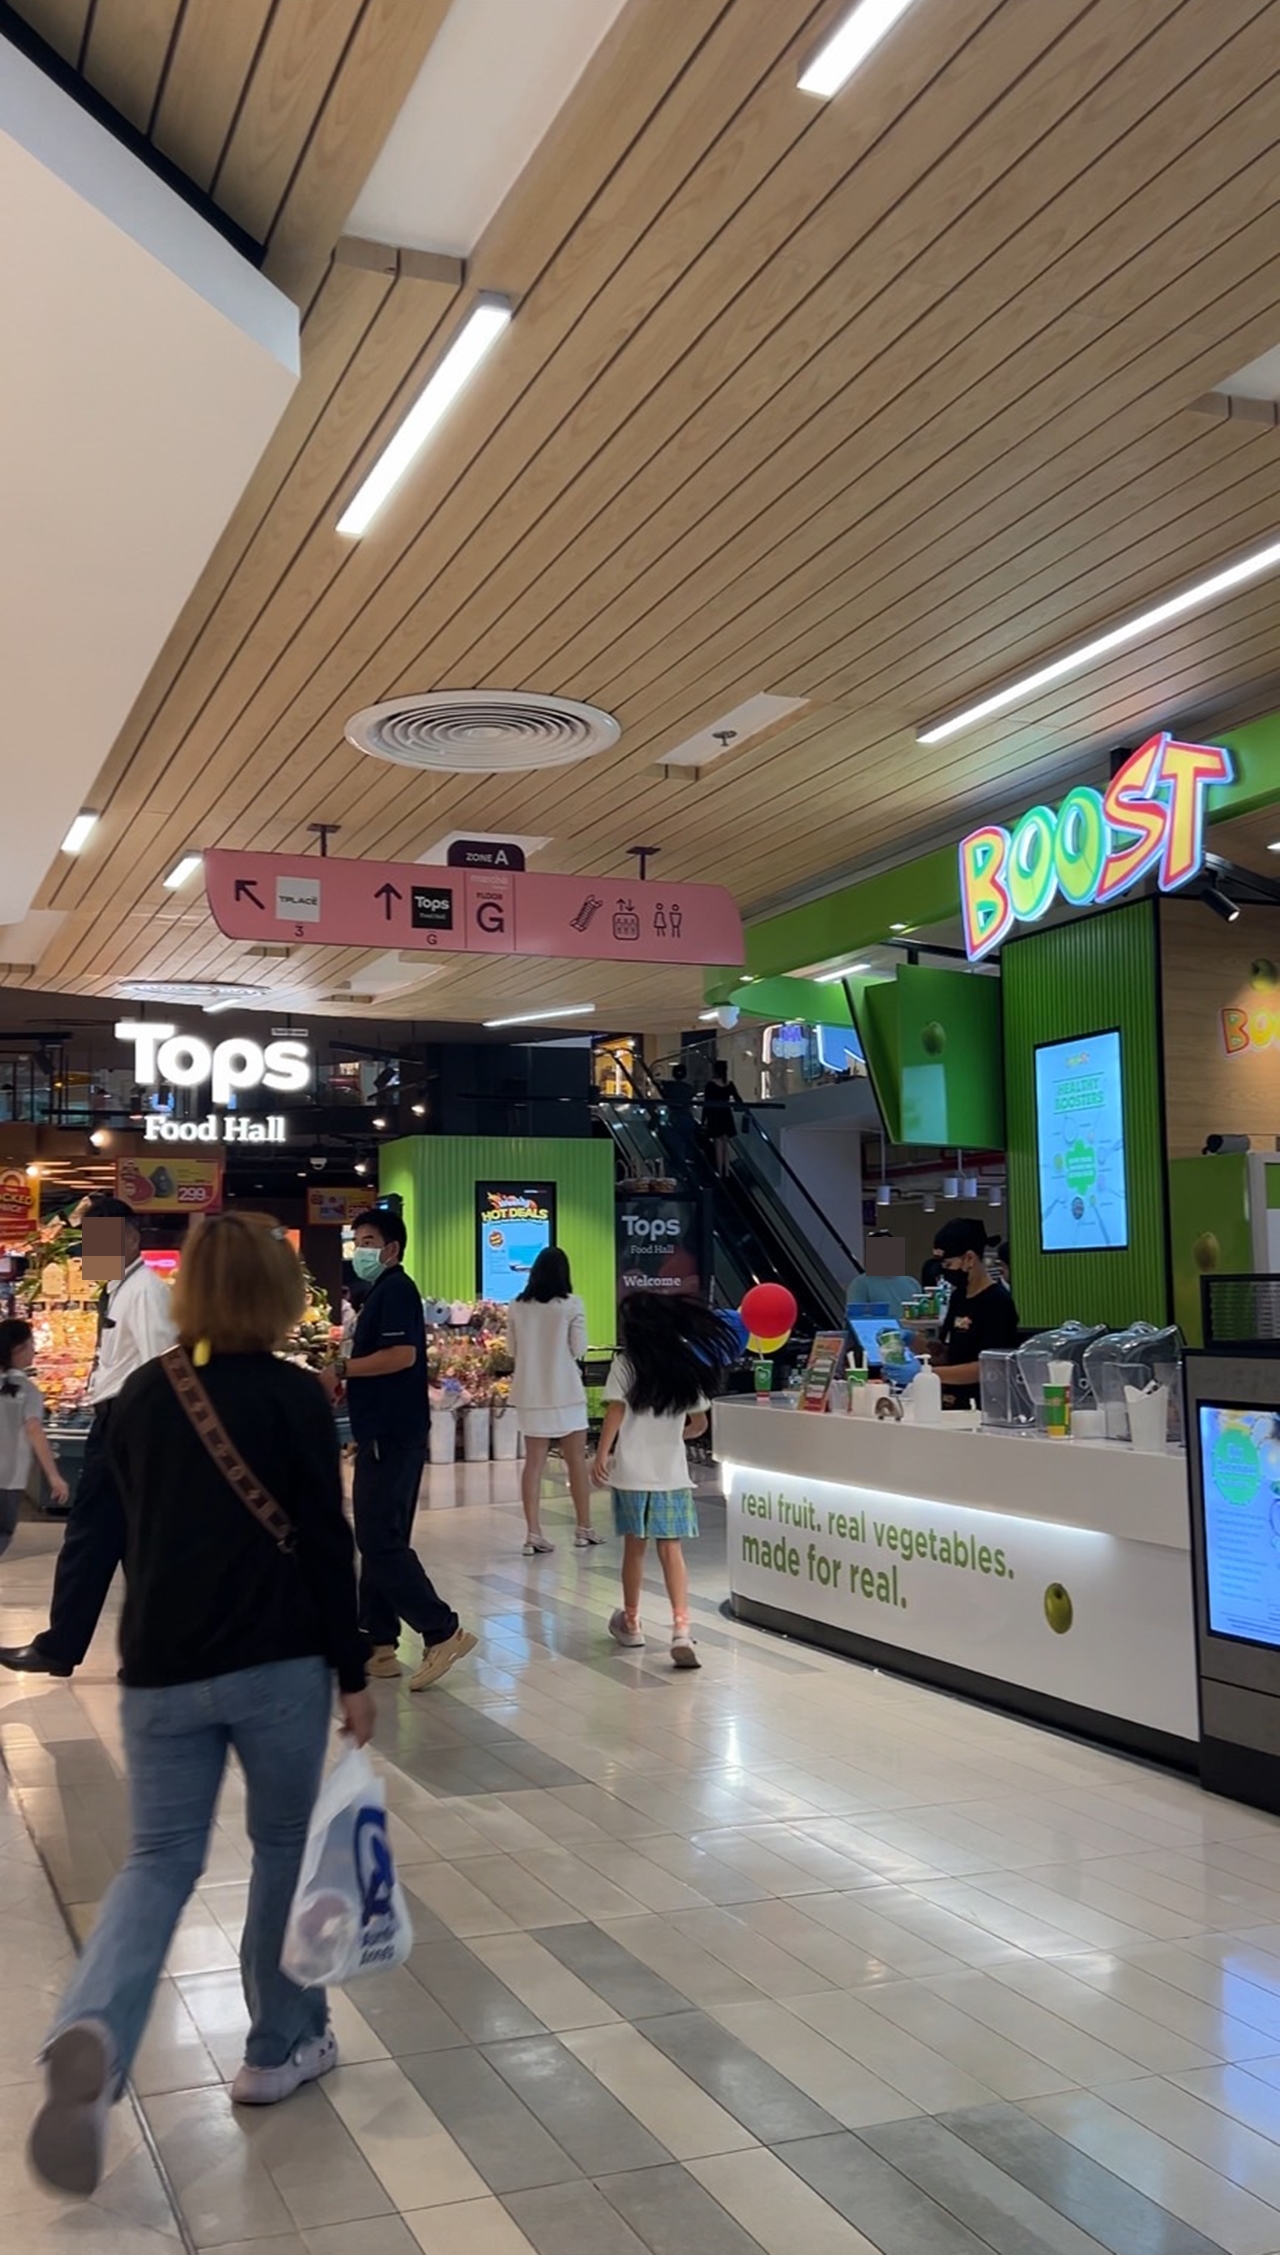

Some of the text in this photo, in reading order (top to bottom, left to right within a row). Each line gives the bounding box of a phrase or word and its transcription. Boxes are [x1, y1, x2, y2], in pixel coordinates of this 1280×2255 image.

[959, 731, 1234, 962] BOOST
[465, 849, 509, 866] ZONE A
[414, 895, 450, 911] Tops
[476, 892, 503, 900] FLOOR
[476, 901, 504, 933] G
[294, 925, 304, 937] 3
[426, 933, 438, 945] G
[1219, 1007, 1280, 1056] BO
[114, 1022, 311, 1104] Tops
[143, 1115, 286, 1143] Food Hall
[481, 1207, 549, 1221] HOT DEALS
[621, 1215, 681, 1241] Tops
[630, 1244, 674, 1254] Food Hall
[622, 1275, 682, 1287] Welcome
[741, 1492, 1014, 1580] real fruit. real vegetables.
[742, 1535, 907, 1609] made for real.
